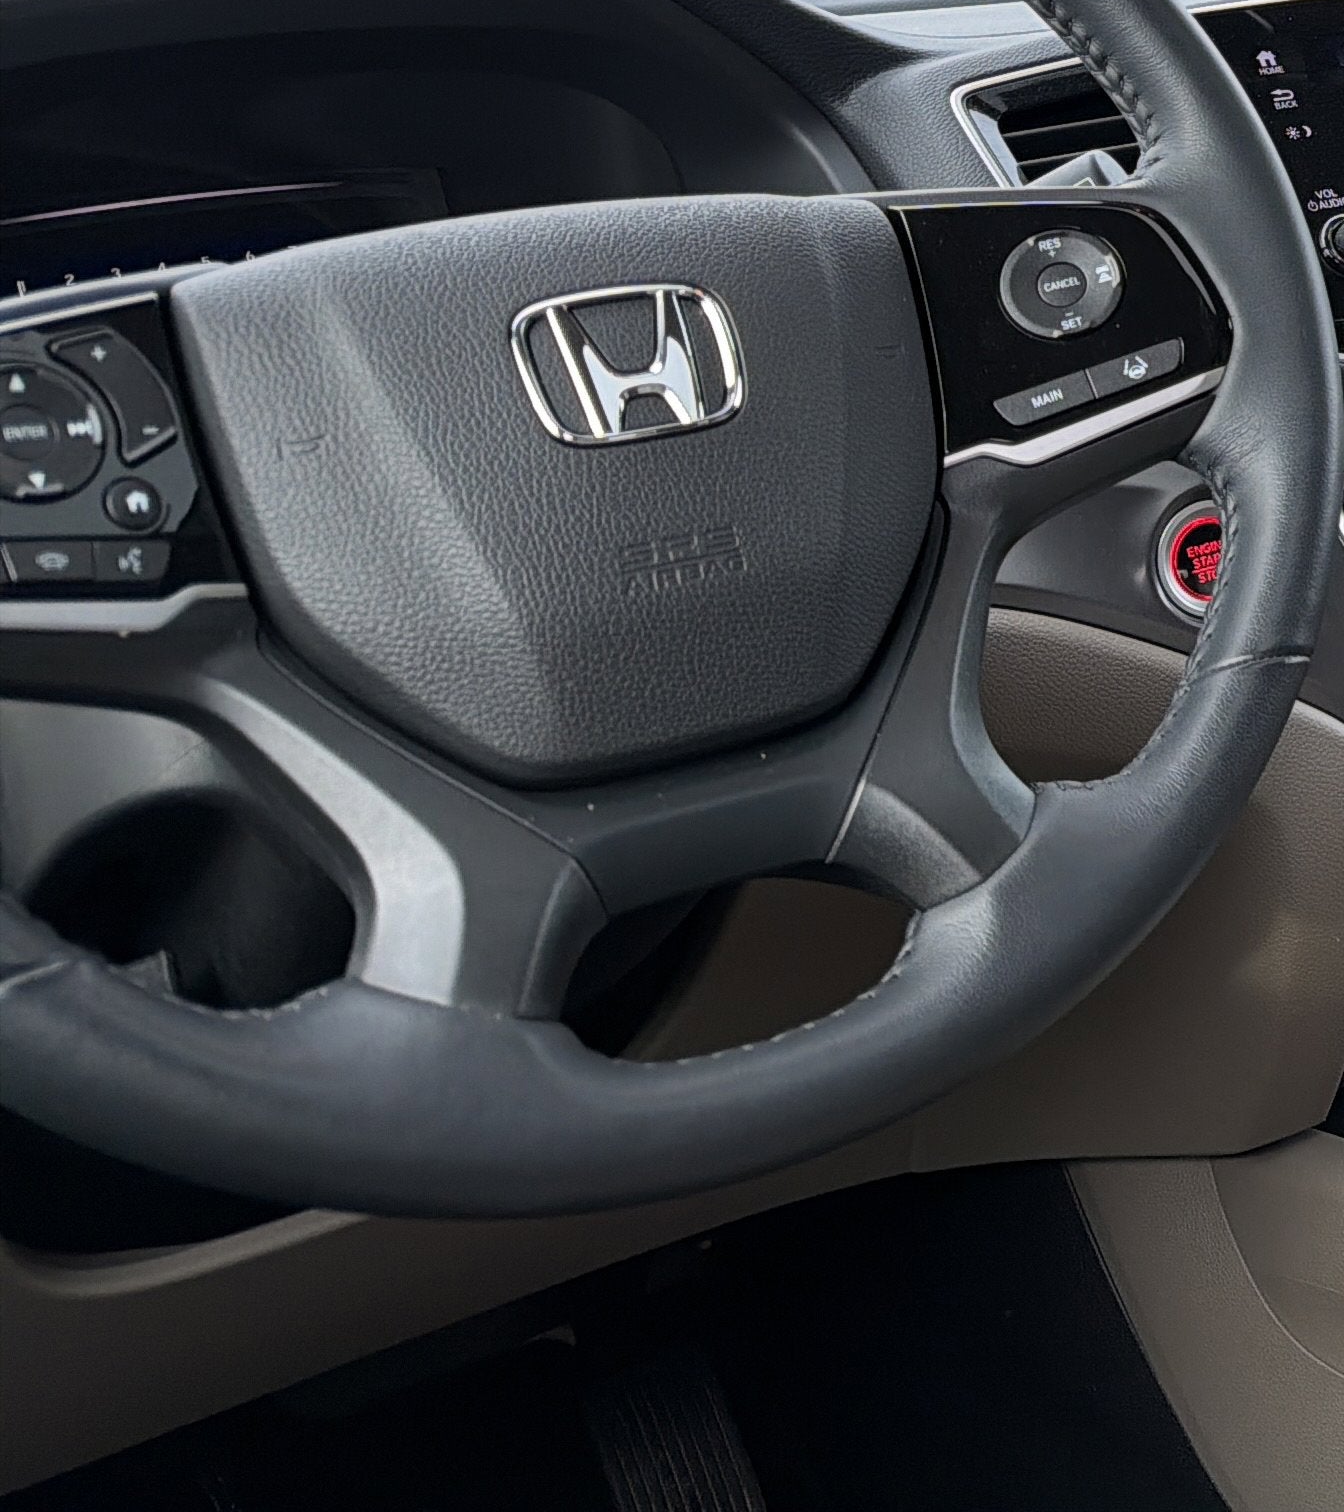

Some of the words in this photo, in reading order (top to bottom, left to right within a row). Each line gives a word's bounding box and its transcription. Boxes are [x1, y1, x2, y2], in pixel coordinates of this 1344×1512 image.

[1258, 64, 1286, 77] HOME
[1273, 100, 1299, 111] BACK
[1313, 188, 1339, 200] VOL
[1037, 238, 1063, 253] RES
[1042, 276, 1082, 293] CANCEL
[1060, 316, 1083, 332] SET
[1031, 388, 1064, 410] MAIN
[1186, 539, 1223, 559] ENGIN
